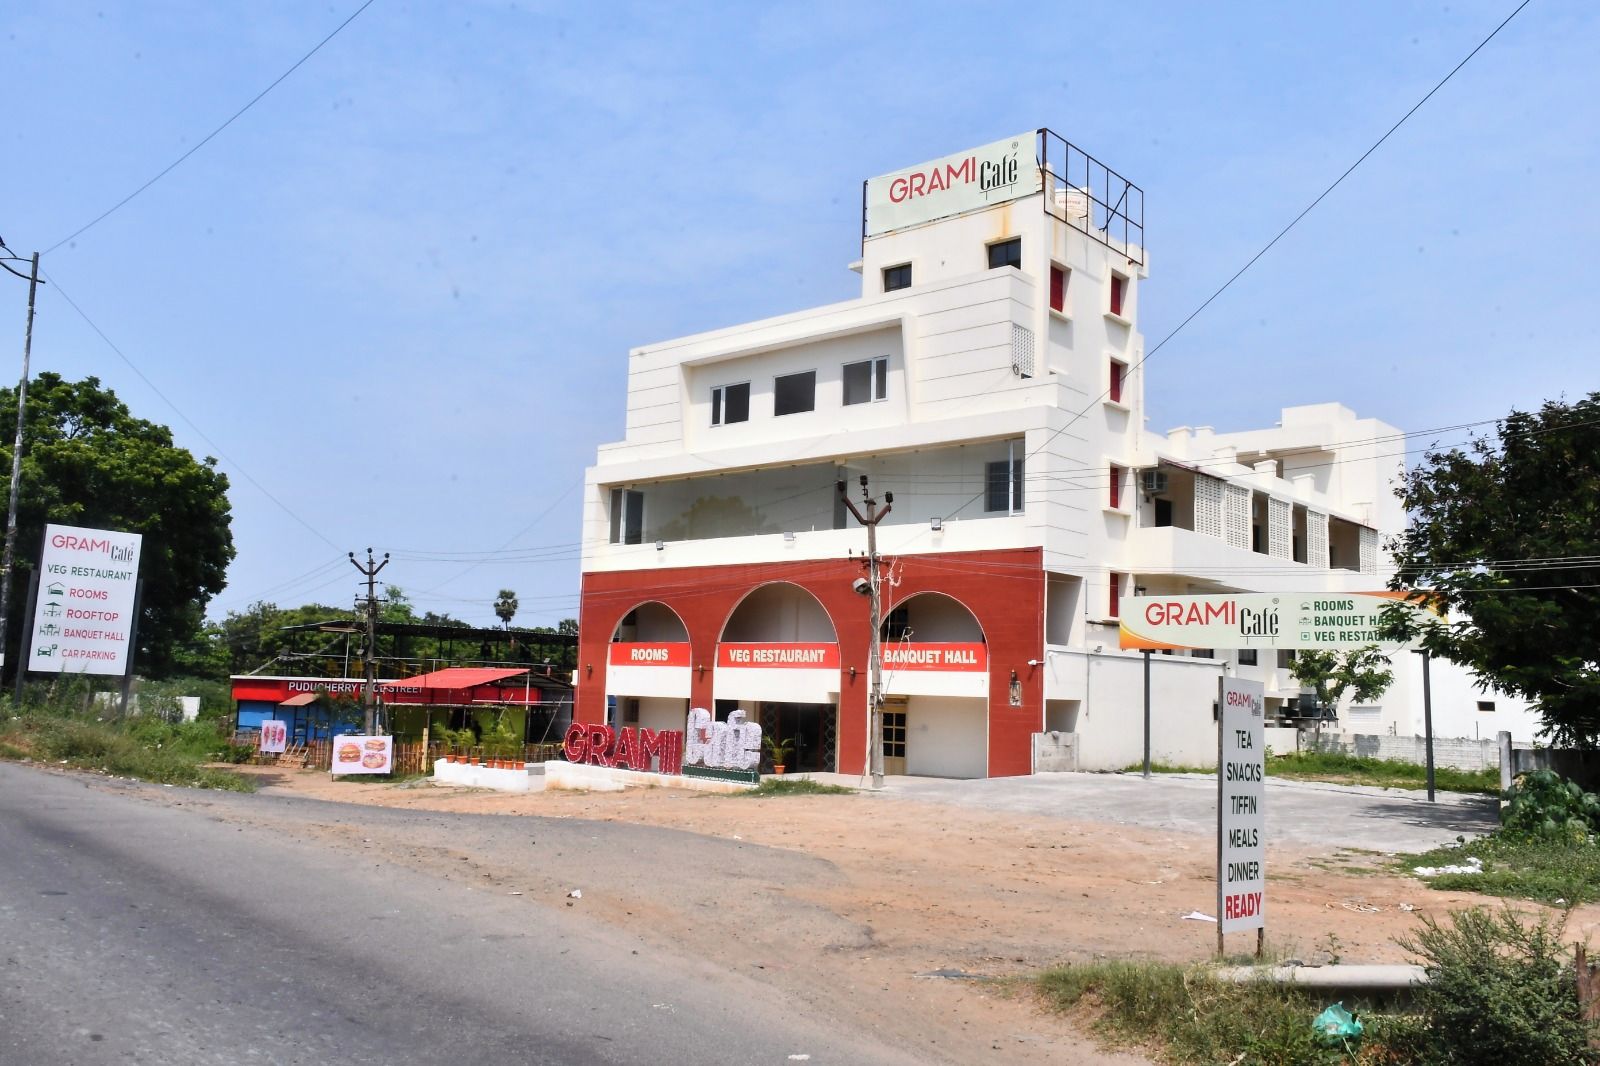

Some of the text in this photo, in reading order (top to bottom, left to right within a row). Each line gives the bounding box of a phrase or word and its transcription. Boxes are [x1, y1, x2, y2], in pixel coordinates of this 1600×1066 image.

[889, 152, 1018, 203] GRAMI Café
[52, 535, 134, 561] GRAMI Café
[47, 564, 133, 580] VEG RESTAURANT
[69, 588, 108, 600] ROOMS
[1314, 600, 1354, 611] ROOMS
[66, 609, 119, 621] ROOFTOP
[1145, 601, 1279, 636] GRAMI Café
[1314, 616, 1365, 627] BANQUET
[63, 629, 125, 641] BANQUET HALL
[1314, 631, 1335, 641] VEG
[61, 649, 116, 661] CAR PARKING
[631, 648, 668, 661] ROOMS
[729, 649, 825, 663] VEG RESTAURANT
[883, 650, 977, 664] BANQUET HALL
[1227, 691, 1251, 708] GRAMI
[1235, 729, 1253, 750] TEA
[563, 722, 683, 776] GRAMI
[1226, 761, 1262, 783] SNACKS
[1230, 795, 1257, 815] TIFFIN
[1229, 828, 1258, 849] MEALS
[1227, 861, 1260, 883] DINNER
[1225, 892, 1262, 920] READY
